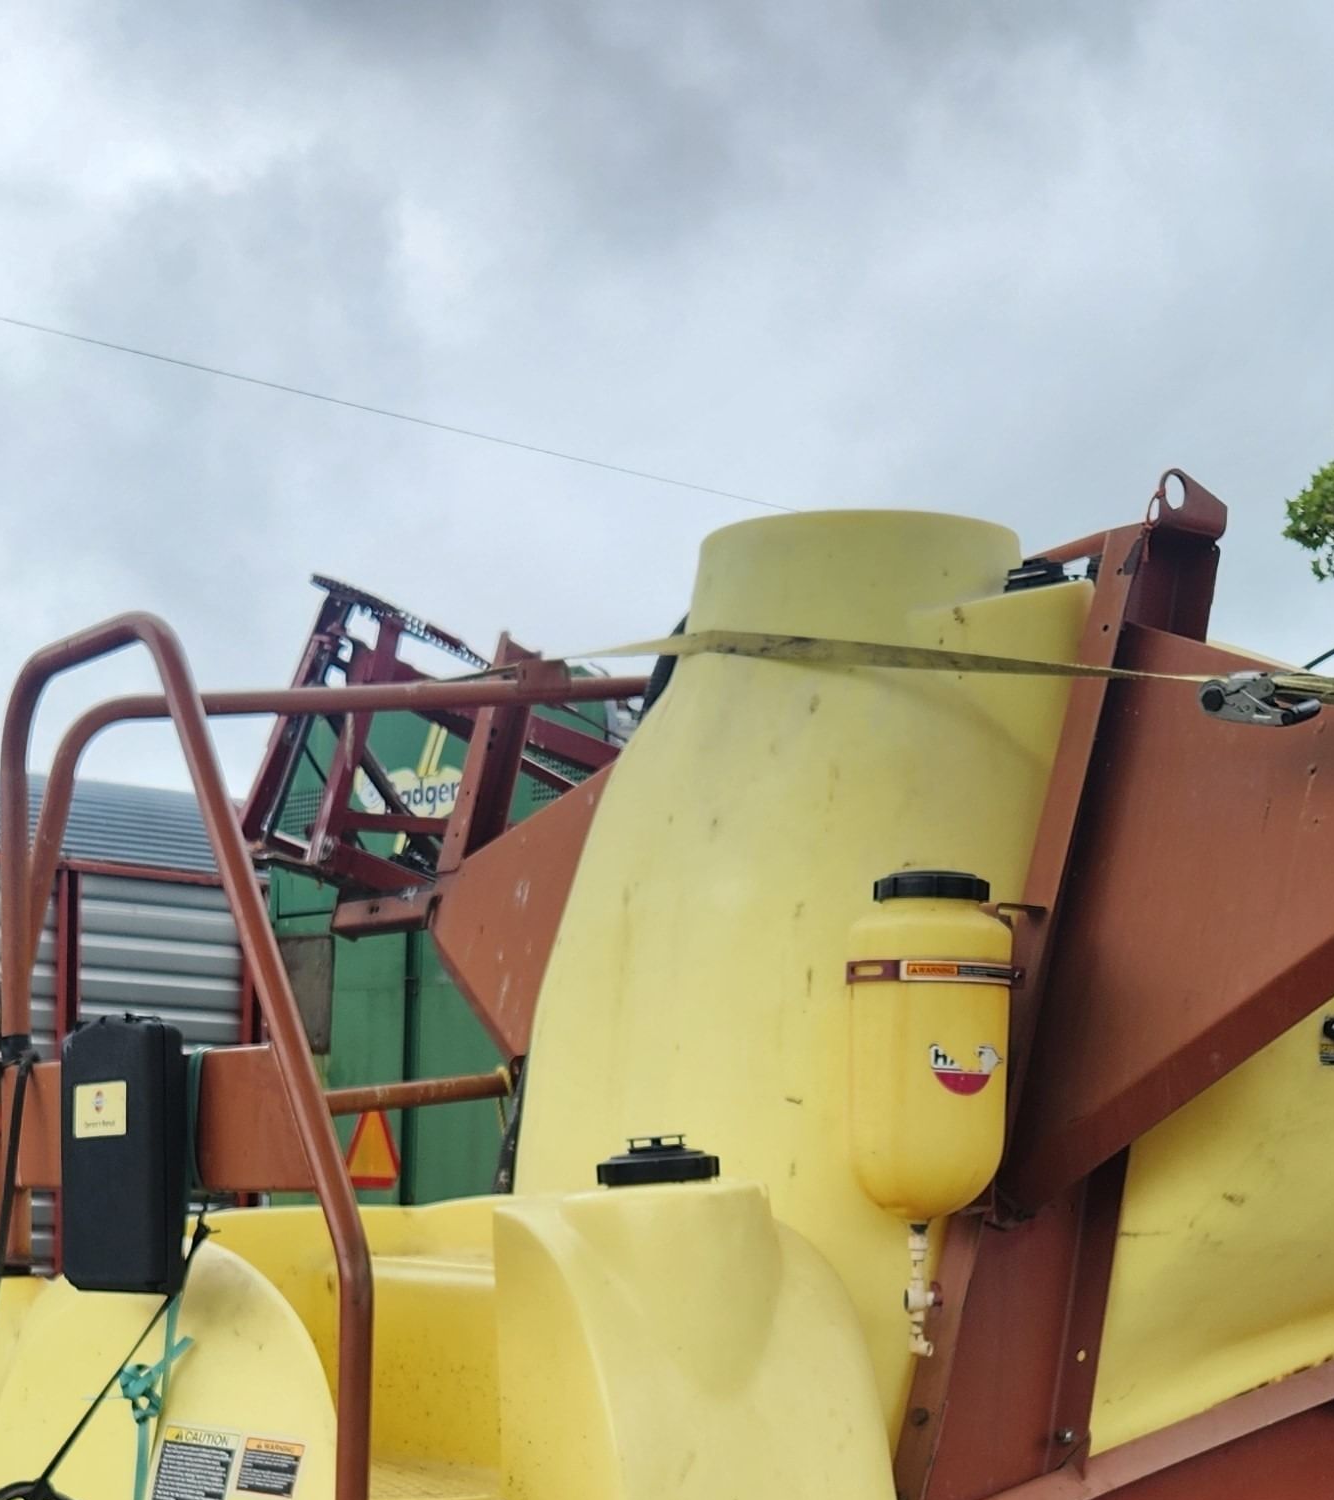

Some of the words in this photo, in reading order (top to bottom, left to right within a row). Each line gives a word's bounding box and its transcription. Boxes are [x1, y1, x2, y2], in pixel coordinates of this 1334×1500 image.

[400, 778, 460, 815] adger
[184, 1430, 229, 1447] CAUTION
[263, 1442, 296, 1455] WARNING
